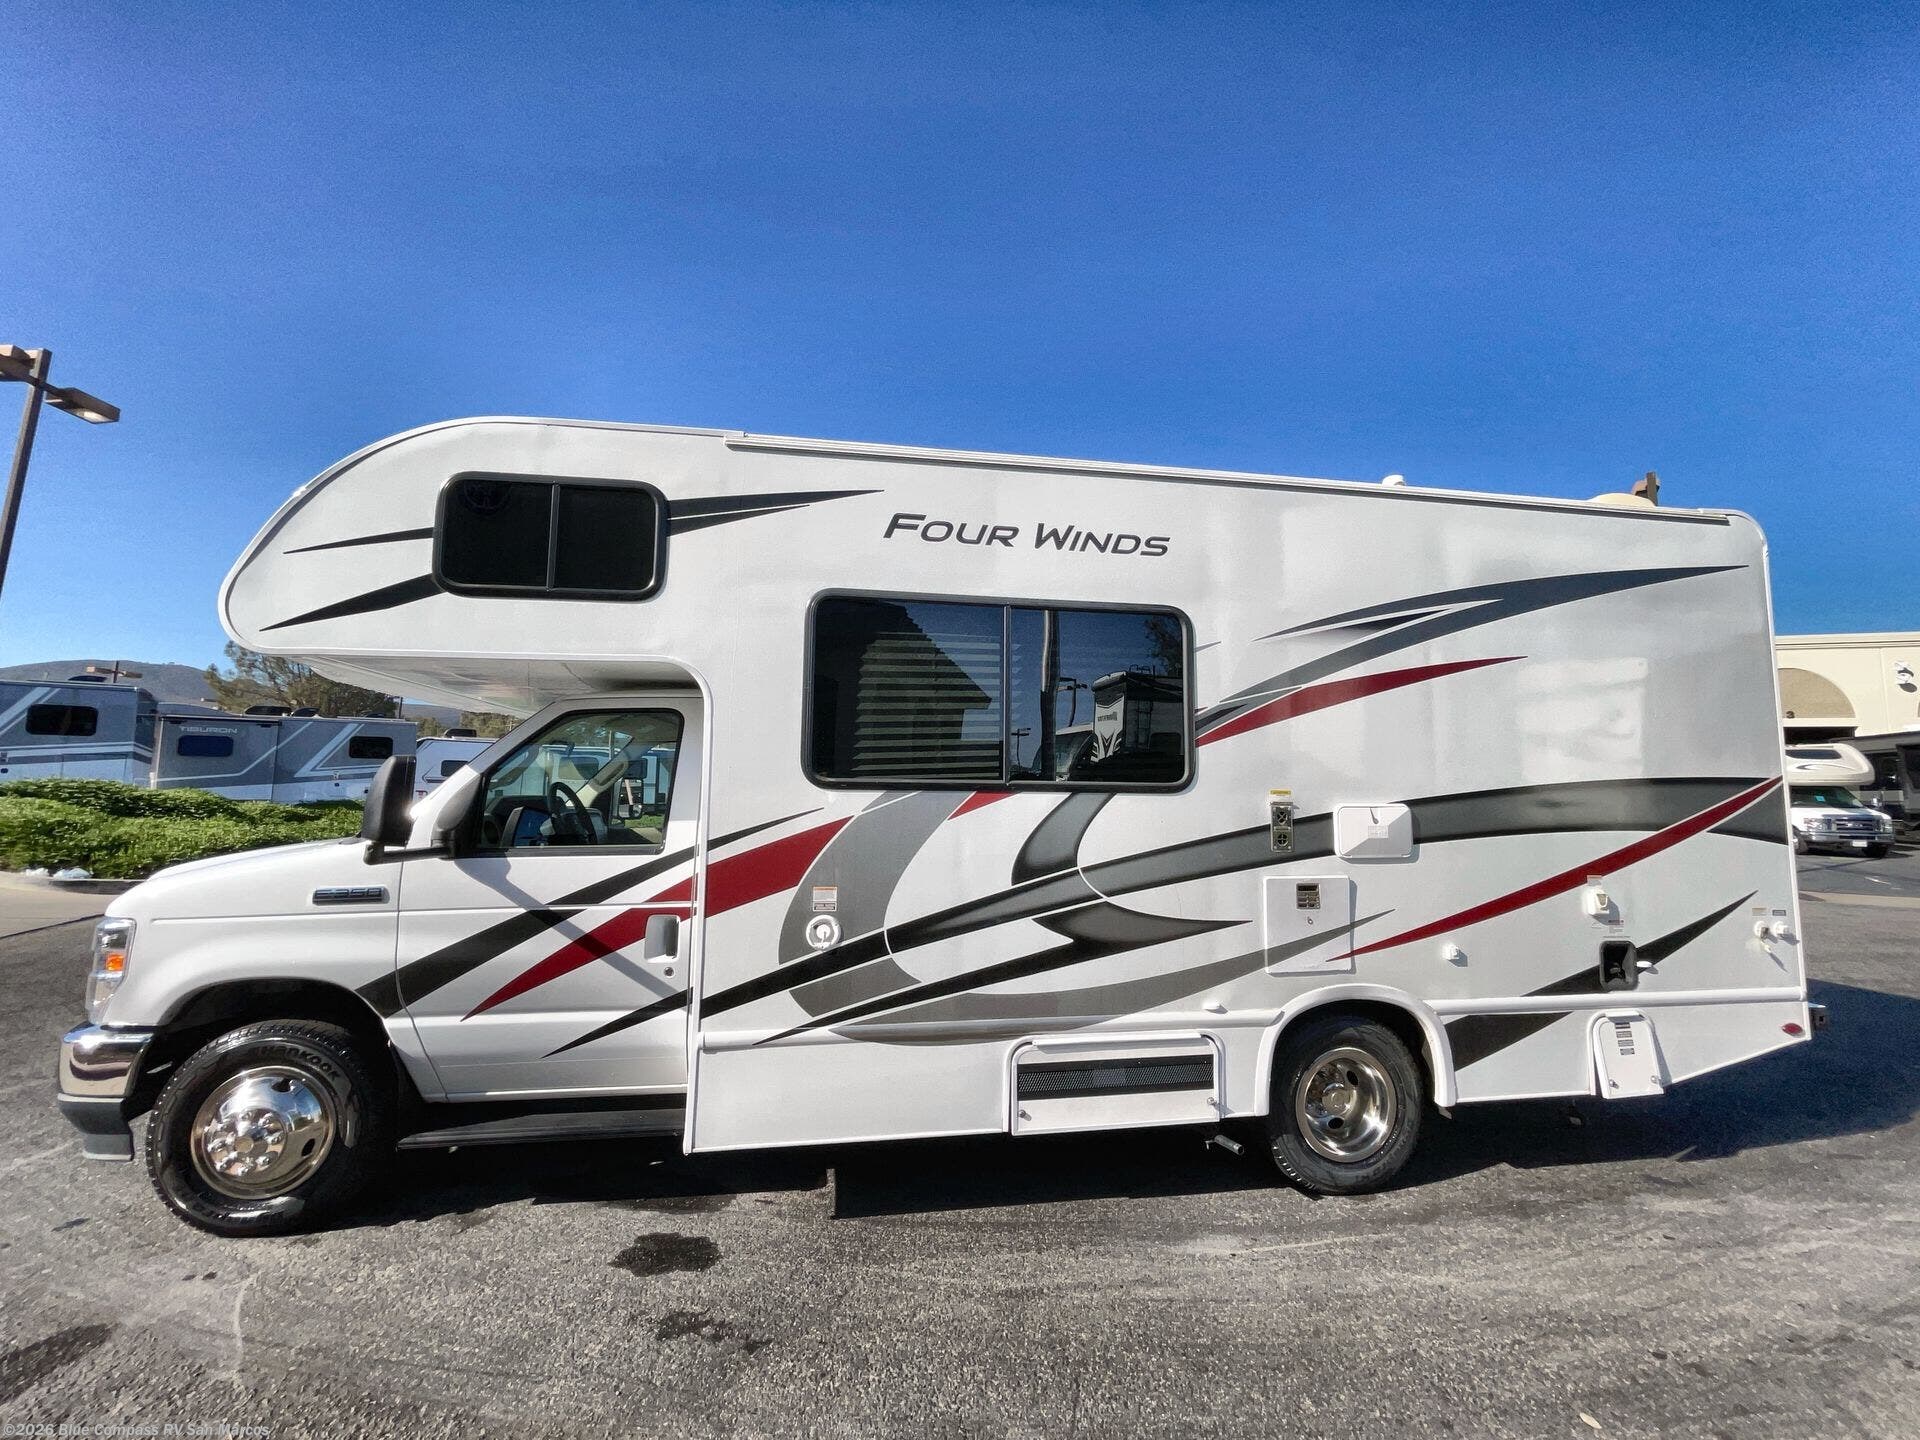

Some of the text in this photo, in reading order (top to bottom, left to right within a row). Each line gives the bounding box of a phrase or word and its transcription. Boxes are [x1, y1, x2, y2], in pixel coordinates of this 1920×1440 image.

[883, 512, 1171, 557] FOUR WINDS
[179, 725, 238, 734] TIBURON
